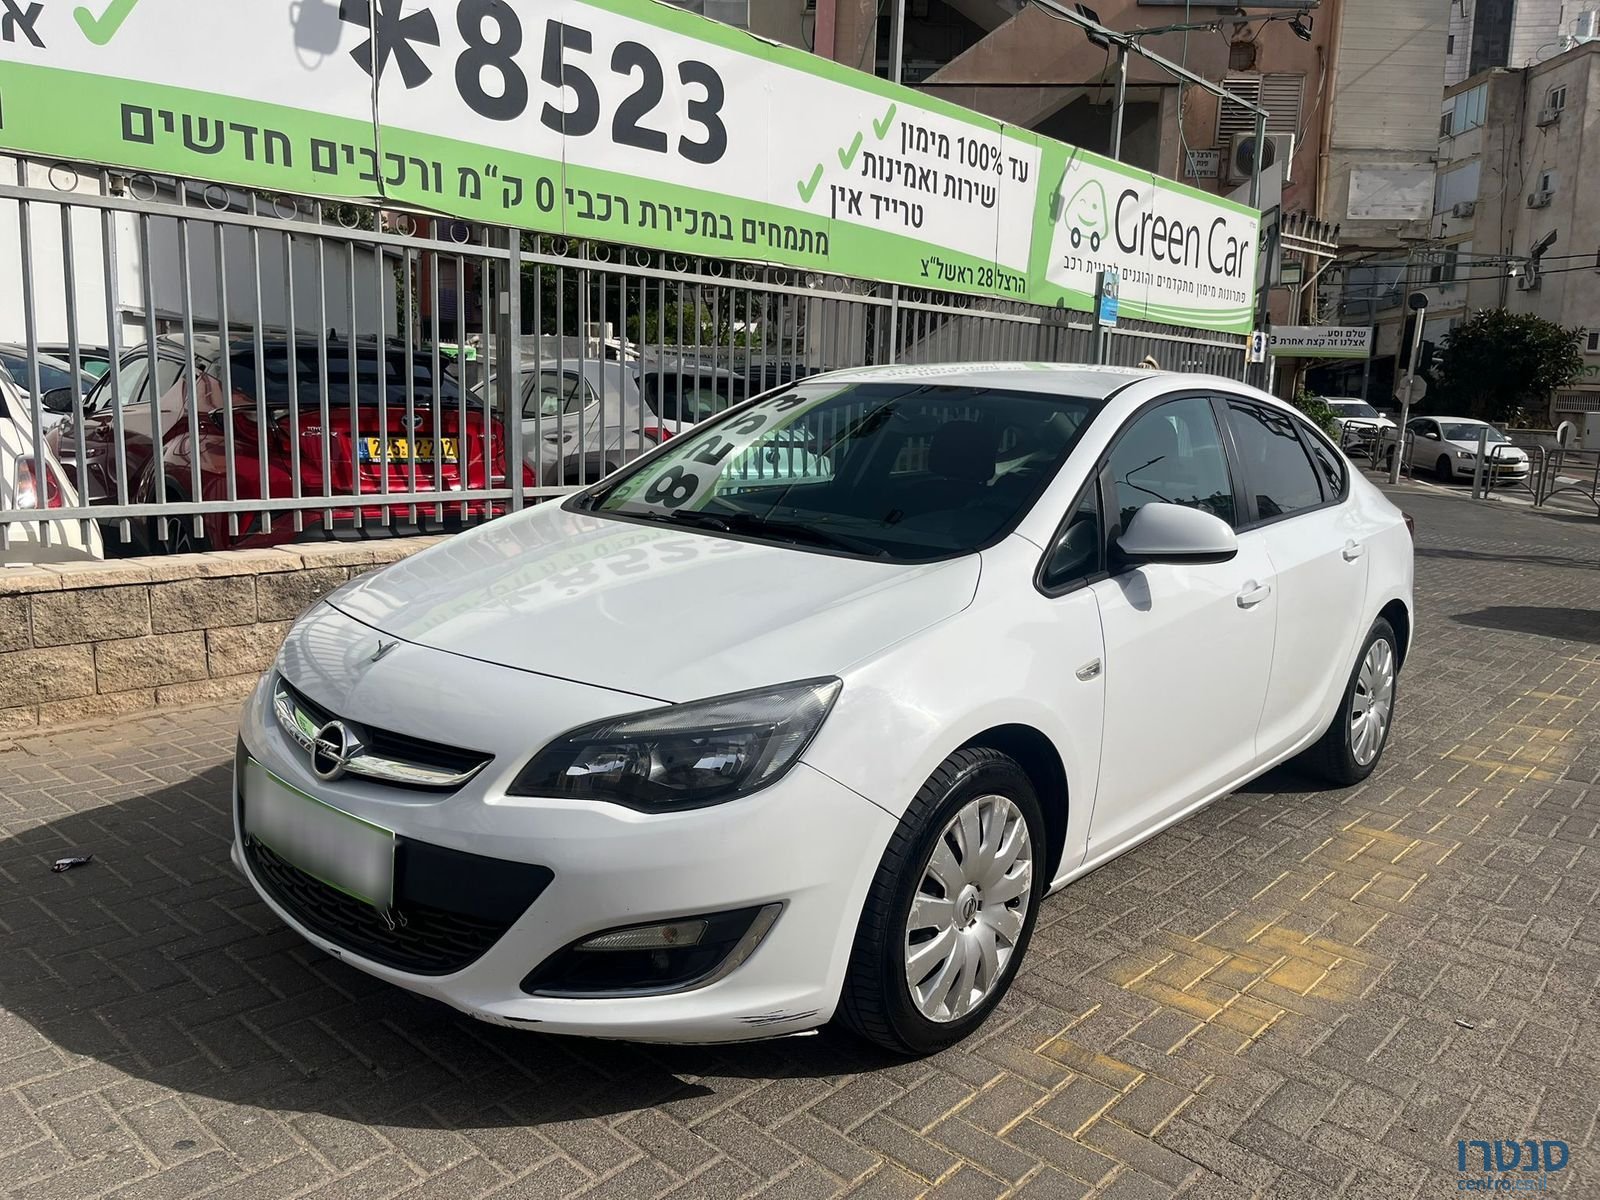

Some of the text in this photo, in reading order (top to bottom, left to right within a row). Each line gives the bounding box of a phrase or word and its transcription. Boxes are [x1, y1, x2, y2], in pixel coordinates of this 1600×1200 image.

[120, 103, 292, 167] חדשים
[310, 137, 443, 194] ורכבים
[901, 122, 1028, 183] עד 100% מימון
[536, 176, 555, 213] 0
[861, 151, 996, 209] שירות ואמינות
[564, 187, 629, 225] רכבי
[638, 199, 733, 242] במכירת
[830, 184, 924, 229] טרייד אין
[743, 218, 829, 256] מתמחים
[1114, 188, 1249, 279] Green Car
[977, 266, 994, 288] 28
[1063, 256, 1083, 271] רכב
[1122, 268, 1154, 286] והוגנים
[996, 269, 1026, 294] הרצל
[1156, 275, 1194, 294] מתקדמים
[1196, 282, 1216, 298] מימון
[1218, 287, 1246, 303] פתרונות
[1306, 338, 1325, 347] קצת
[1340, 338, 1365, 346] אצלנו
[1345, 329, 1366, 338] שלם
